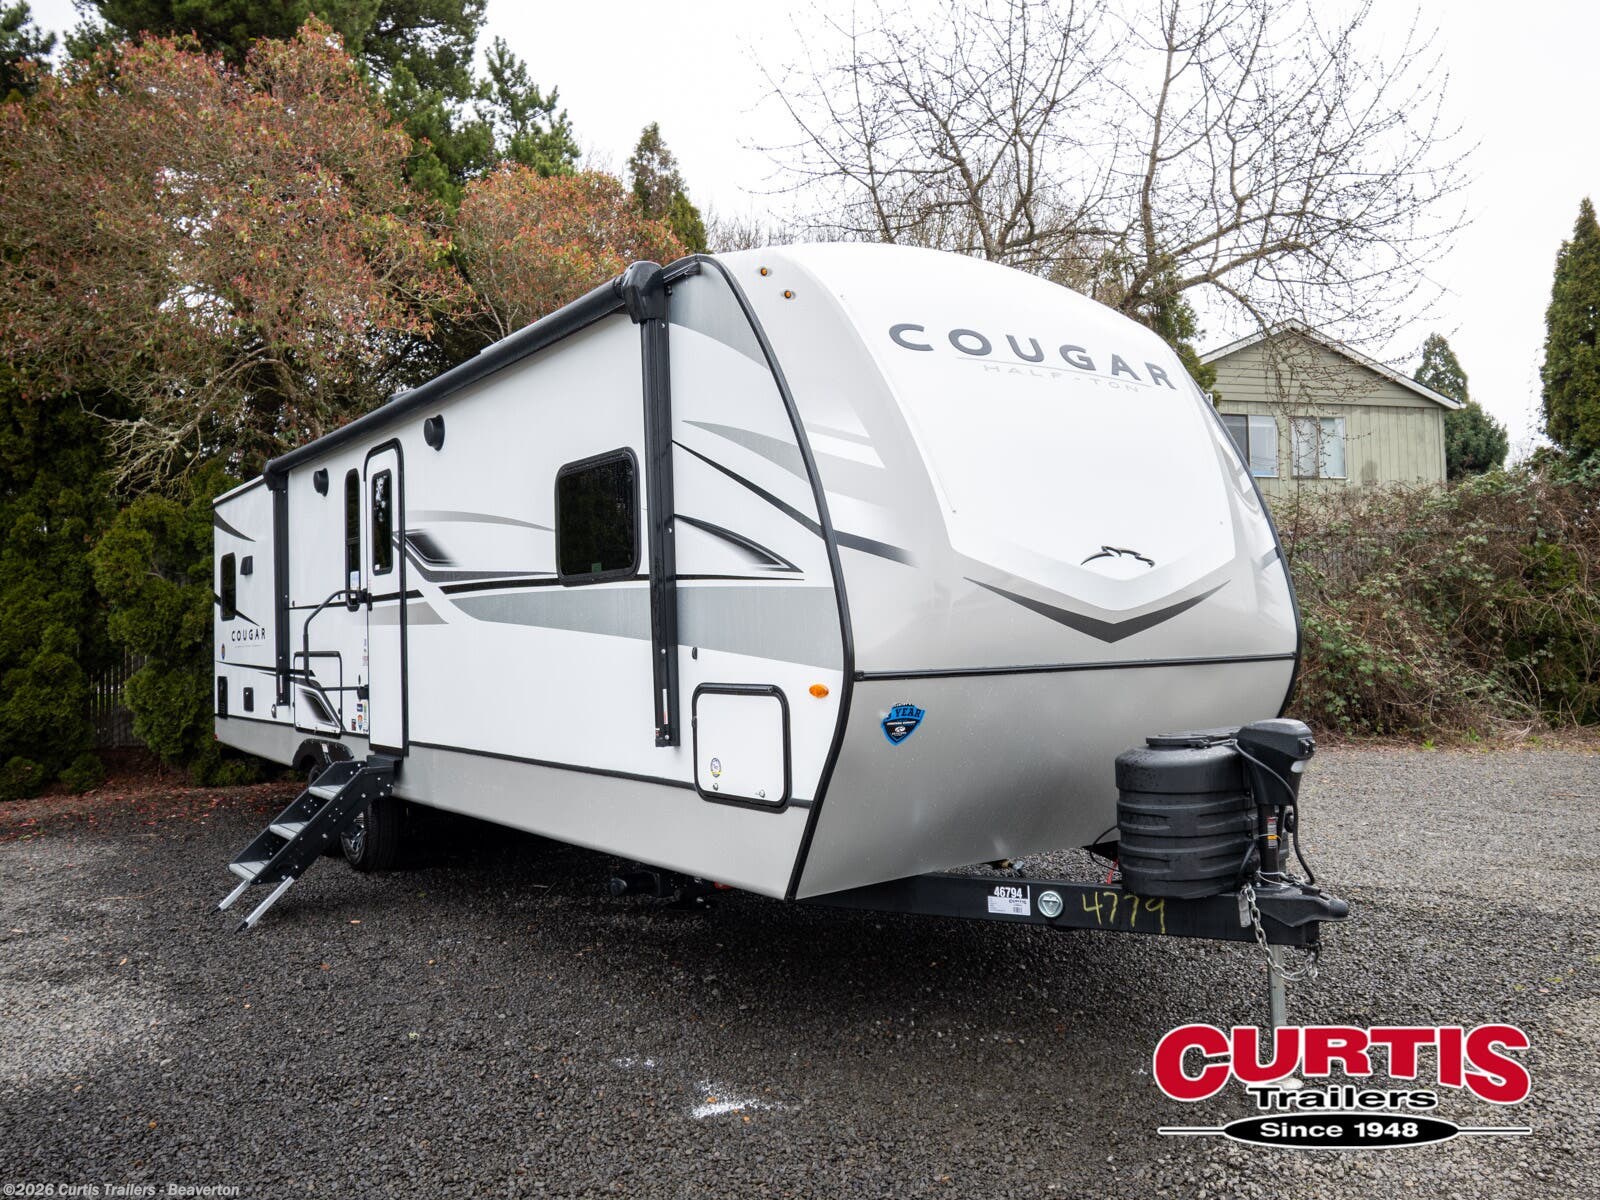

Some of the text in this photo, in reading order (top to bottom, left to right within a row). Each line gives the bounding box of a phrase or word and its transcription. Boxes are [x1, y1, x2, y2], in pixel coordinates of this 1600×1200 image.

[888, 323, 1177, 390] COUGAR
[231, 628, 266, 642] COUGAR
[895, 708, 921, 718] YEAR
[993, 886, 1022, 899] 46794
[1082, 891, 1166, 934] 4779
